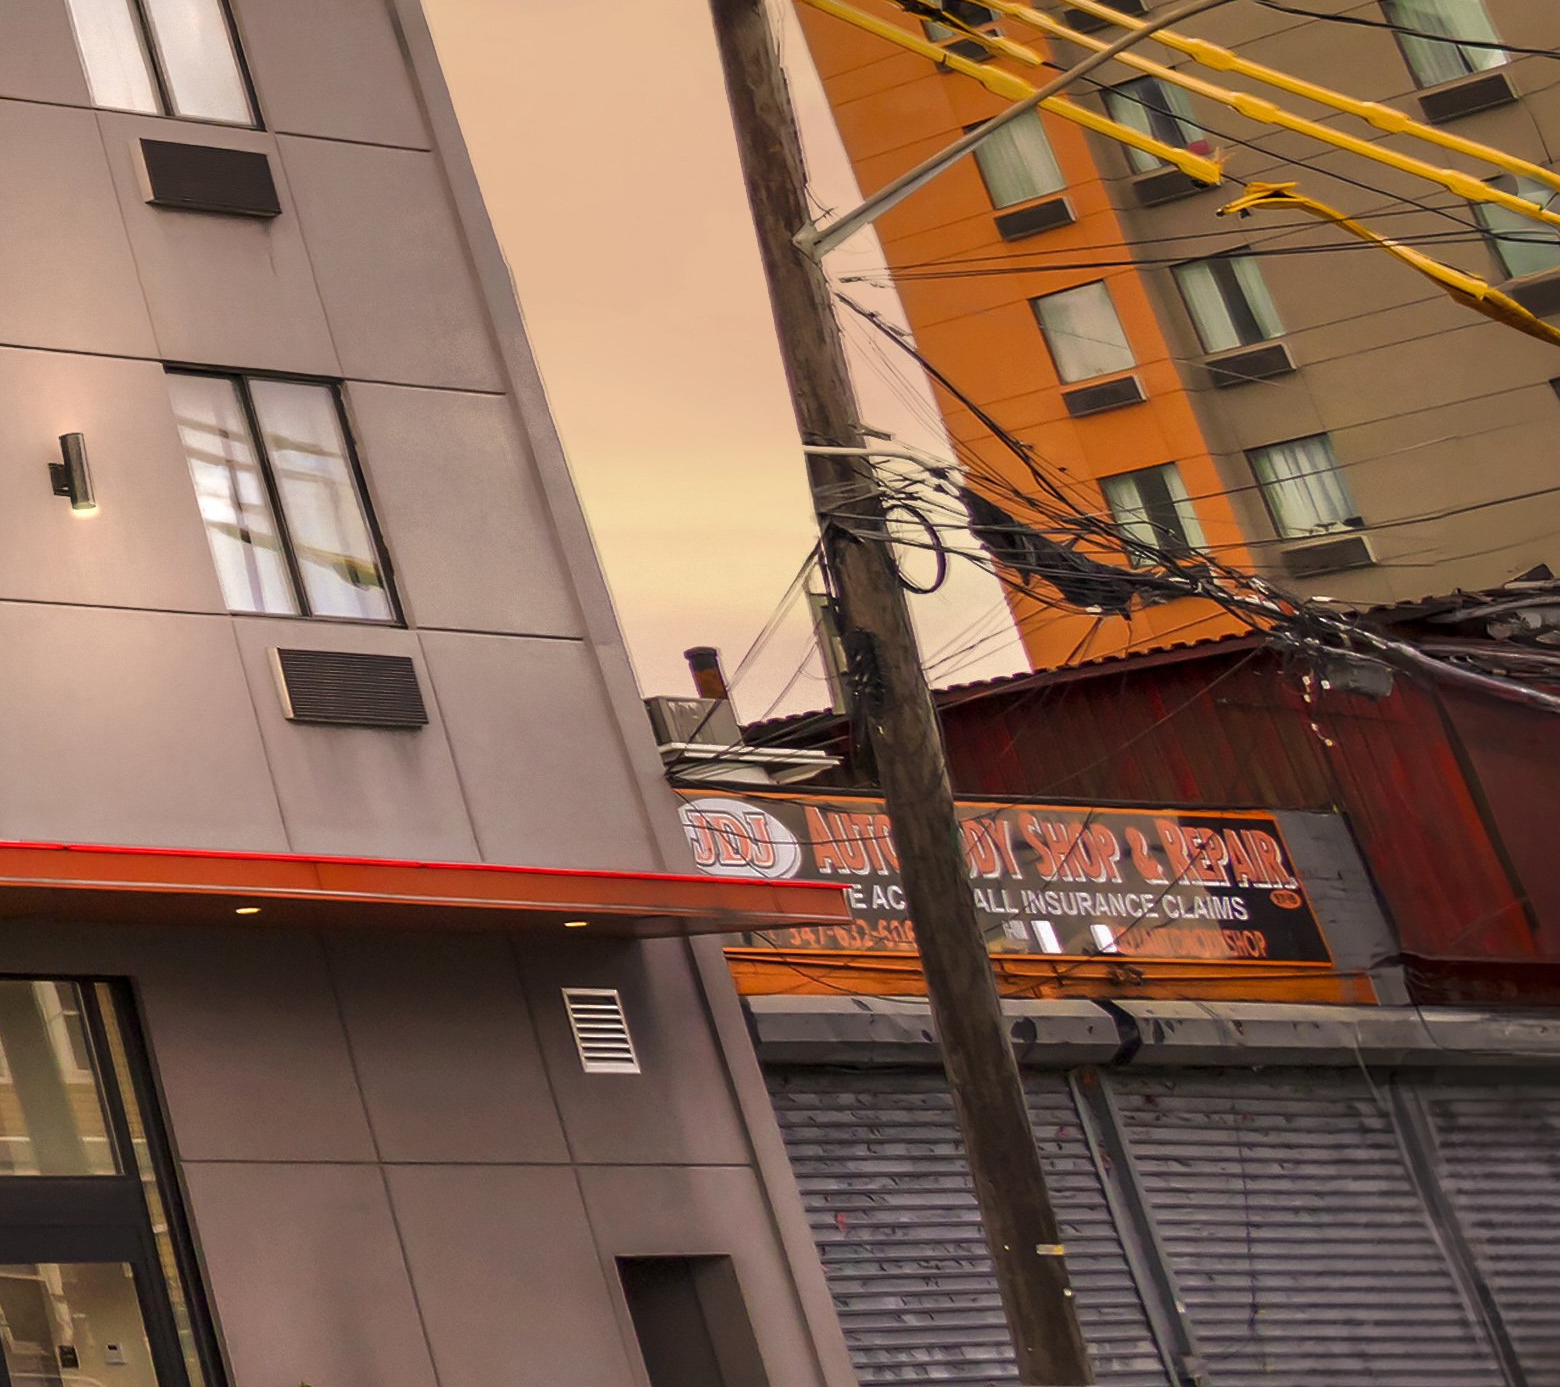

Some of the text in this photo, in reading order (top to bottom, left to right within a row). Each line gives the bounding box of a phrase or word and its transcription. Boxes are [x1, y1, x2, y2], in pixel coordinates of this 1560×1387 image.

[684, 809, 776, 867] JDJ
[1019, 812, 1122, 883] SHOP
[1125, 827, 1169, 885] &
[974, 888, 1019, 913] ALL
[1022, 889, 1159, 917] INSURANCE
[1162, 894, 1249, 920] CLAIMS
